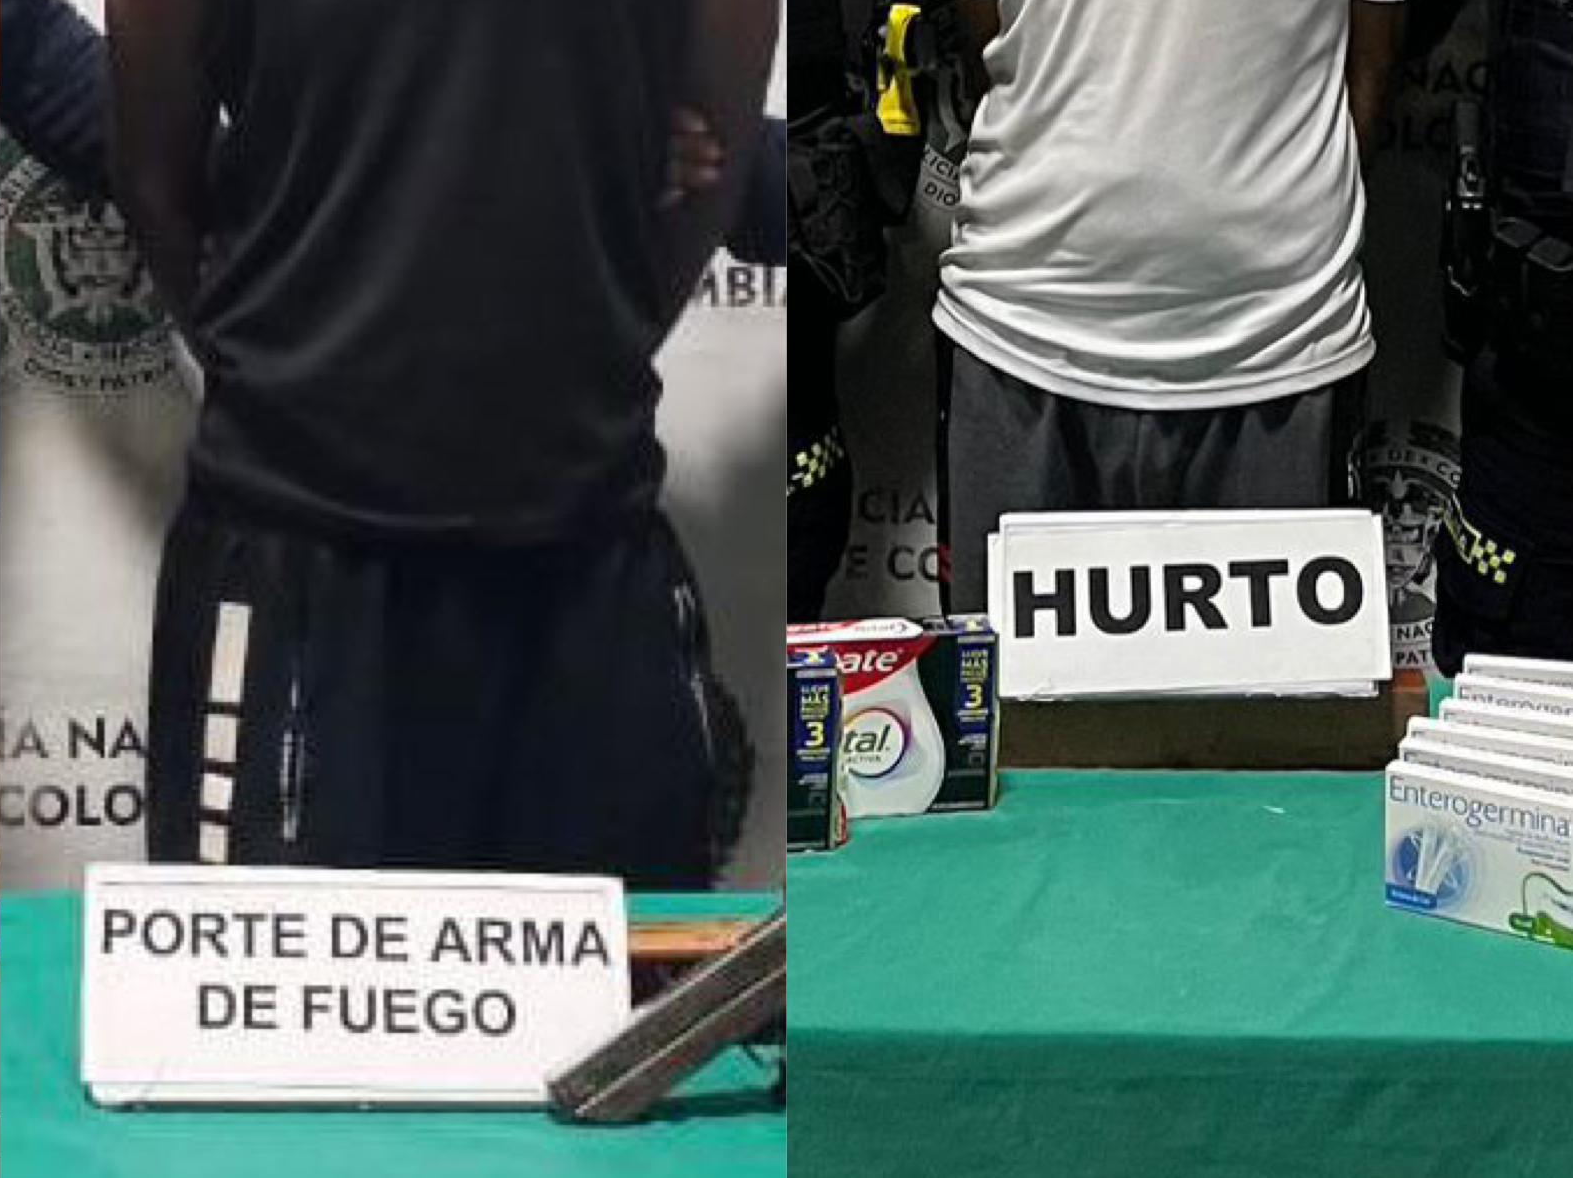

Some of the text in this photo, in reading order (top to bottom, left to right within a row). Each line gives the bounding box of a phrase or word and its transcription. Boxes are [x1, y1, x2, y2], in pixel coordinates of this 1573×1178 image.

[1012, 556, 1364, 639] HURTO
[1388, 774, 1572, 837] Enterogermina
[103, 908, 610, 966] PORTE DE ARMA
[199, 985, 517, 1037] DE FUEGO
